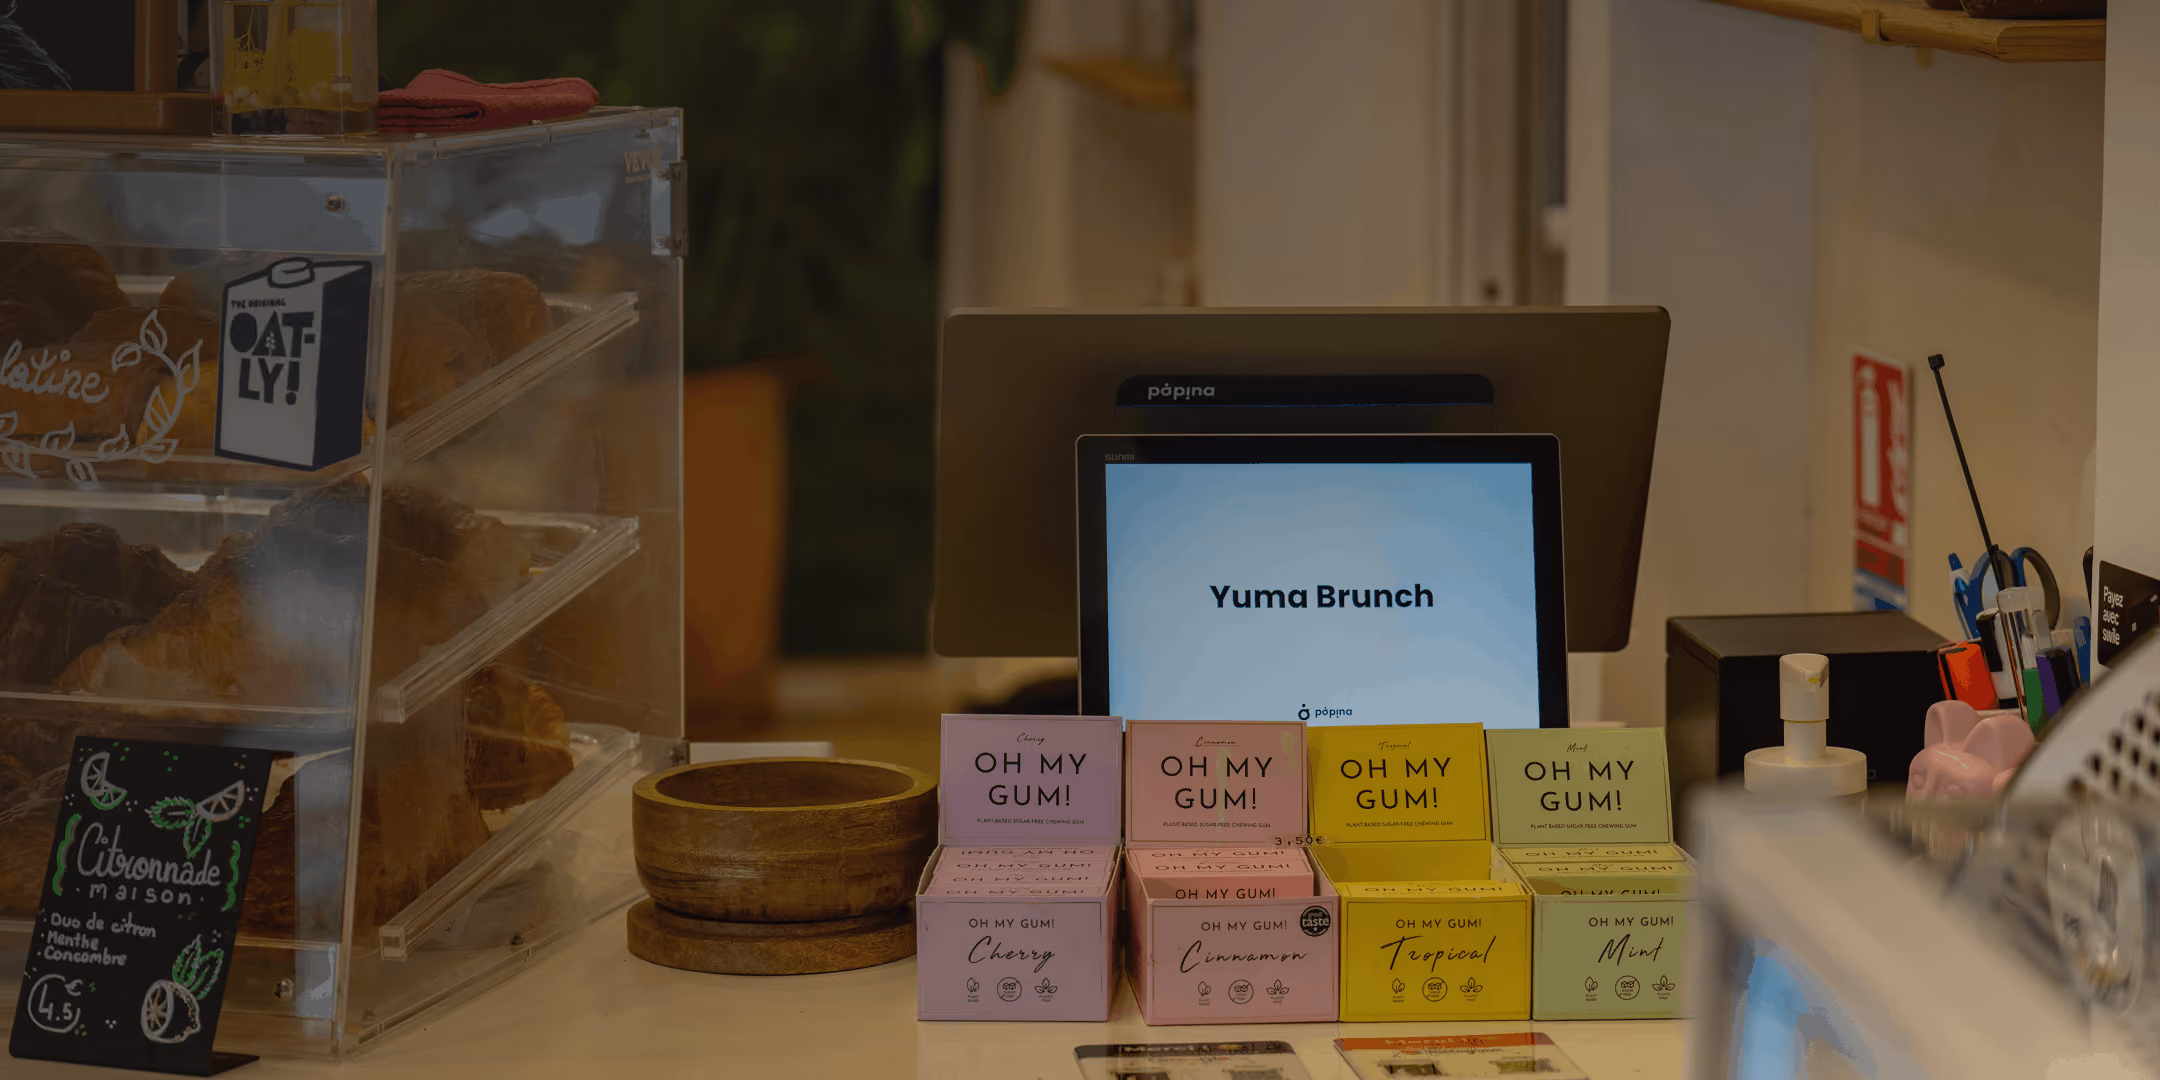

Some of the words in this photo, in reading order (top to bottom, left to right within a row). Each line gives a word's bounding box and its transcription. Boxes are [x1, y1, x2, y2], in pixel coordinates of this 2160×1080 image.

[231, 300, 246, 309] THE
[230, 310, 316, 358] OAT-
[239, 358, 301, 405] LY!
[1210, 585, 1308, 608] Yuma
[1317, 584, 1434, 608] Brunch
[2103, 585, 2123, 608] Payez
[2102, 609, 2120, 626] avec
[975, 752, 1021, 774] OH
[1040, 752, 1087, 775] MY
[1160, 755, 1207, 777] OH
[1226, 756, 1273, 778] MY
[1340, 758, 1387, 779] OH
[1405, 757, 1451, 778] MY
[1524, 761, 1571, 781] OH
[1588, 760, 1635, 781] MY
[988, 784, 1070, 807] GUM!
[1174, 787, 1257, 809] GUM!
[1356, 787, 1438, 810] GUM!
[1540, 790, 1622, 812] GUM!
[78, 822, 222, 887] Citronnade
[90, 884, 192, 905] maison
[1175, 889, 1198, 900] OH
[1206, 888, 1229, 900] MY
[1236, 887, 1276, 899] GUM!
[50, 912, 80, 930] Duo
[86, 912, 104, 931] de
[111, 912, 156, 938] citron
[968, 918, 988, 928] OH
[995, 918, 1015, 929] MY
[1020, 918, 1055, 929] GUM!
[1201, 921, 1221, 931] OH
[1227, 921, 1247, 931] MY
[1253, 919, 1287, 930] GUM!
[1395, 919, 1416, 929] OH
[1422, 918, 1442, 929] MY
[1448, 918, 1482, 929] GUM!
[1588, 917, 1608, 927] OH
[1615, 916, 1635, 927] MY
[1640, 915, 1674, 927] GUM!
[47, 931, 99, 950] Menthe
[1598, 933, 1665, 967] Mint
[44, 946, 127, 966] Concombre
[968, 935, 1056, 974] Cherry
[1180, 940, 1308, 974] Cinnamon
[1380, 935, 1497, 974] Tropical
[38, 984, 73, 1021] 4.5
